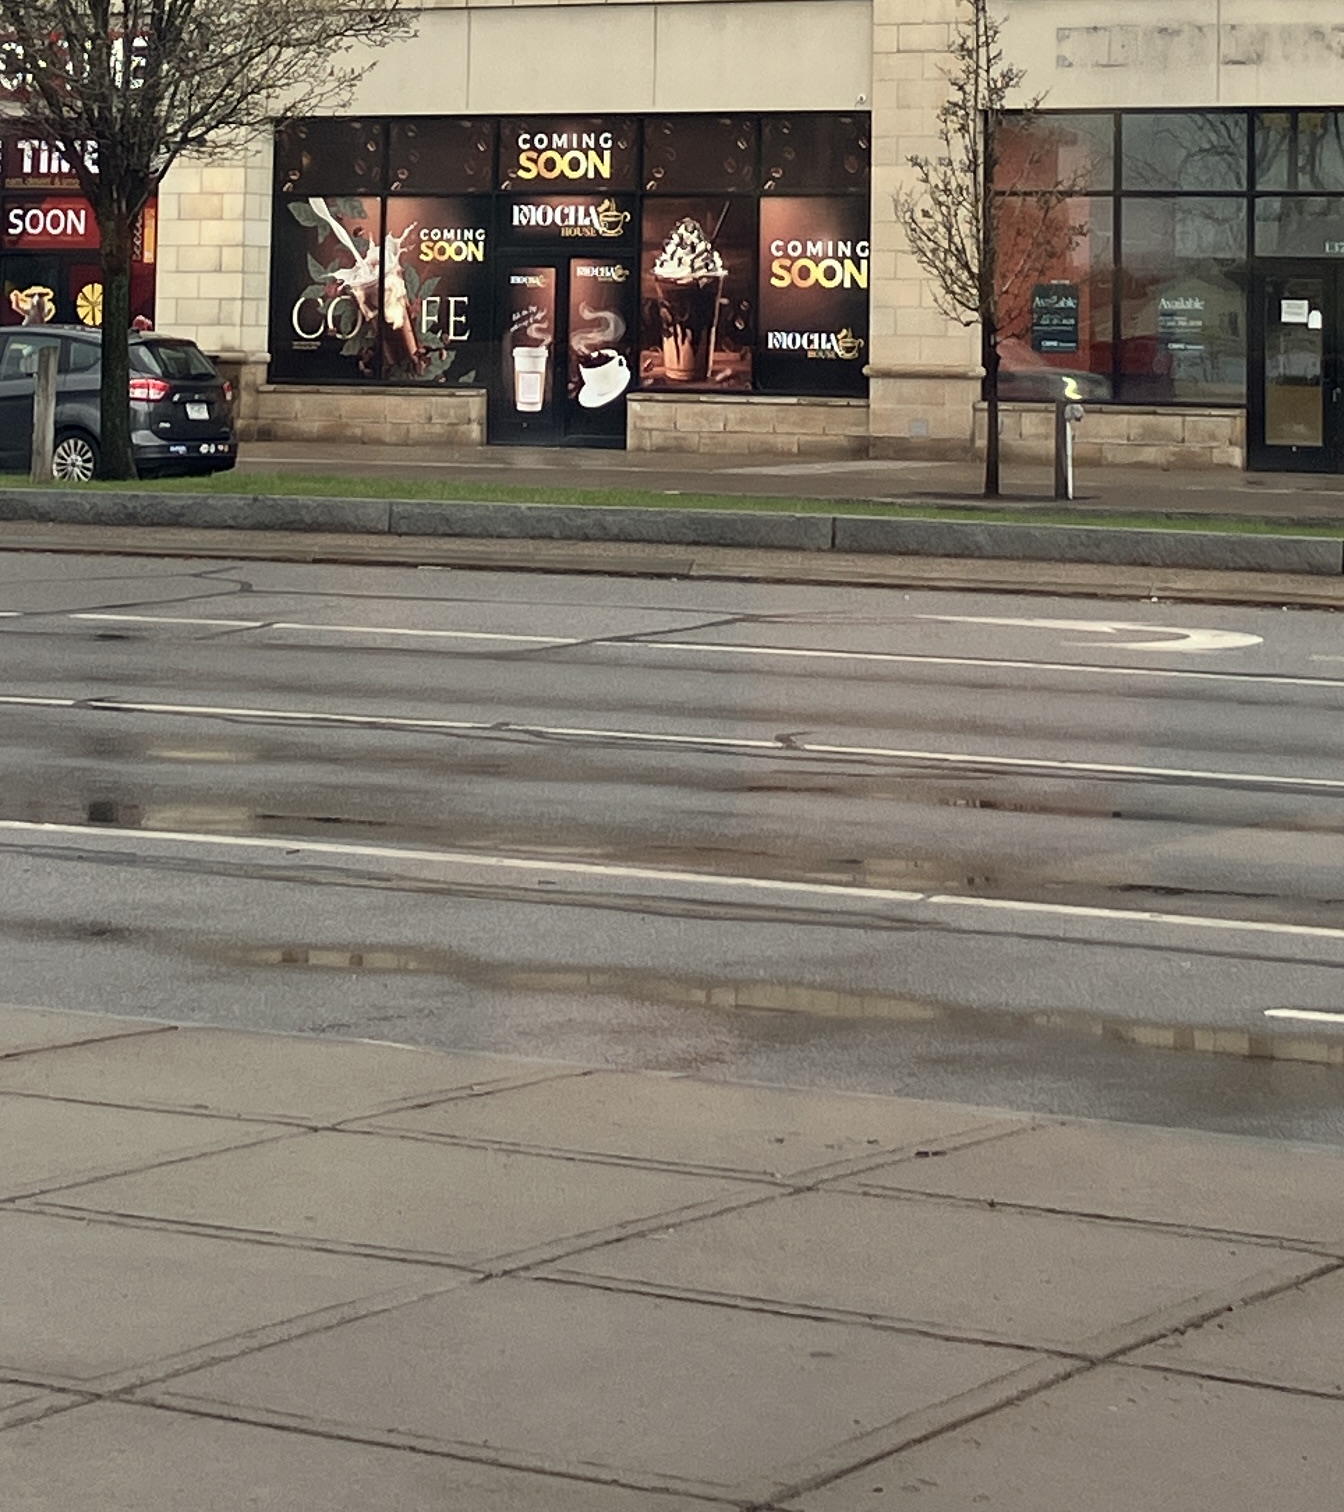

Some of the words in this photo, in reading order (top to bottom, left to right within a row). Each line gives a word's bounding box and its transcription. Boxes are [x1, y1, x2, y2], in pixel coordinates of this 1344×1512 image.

[518, 132, 613, 149] COMING
[517, 149, 612, 179] SOON
[8, 209, 86, 235] SOON
[512, 204, 600, 230] MOCHA
[419, 229, 486, 241] COMING
[561, 227, 597, 237] HOUSE
[419, 241, 486, 262] SOON
[770, 240, 869, 257] COMING
[770, 258, 868, 288] SOON
[1158, 297, 1205, 310] Available
[767, 331, 840, 354] MOCHA
